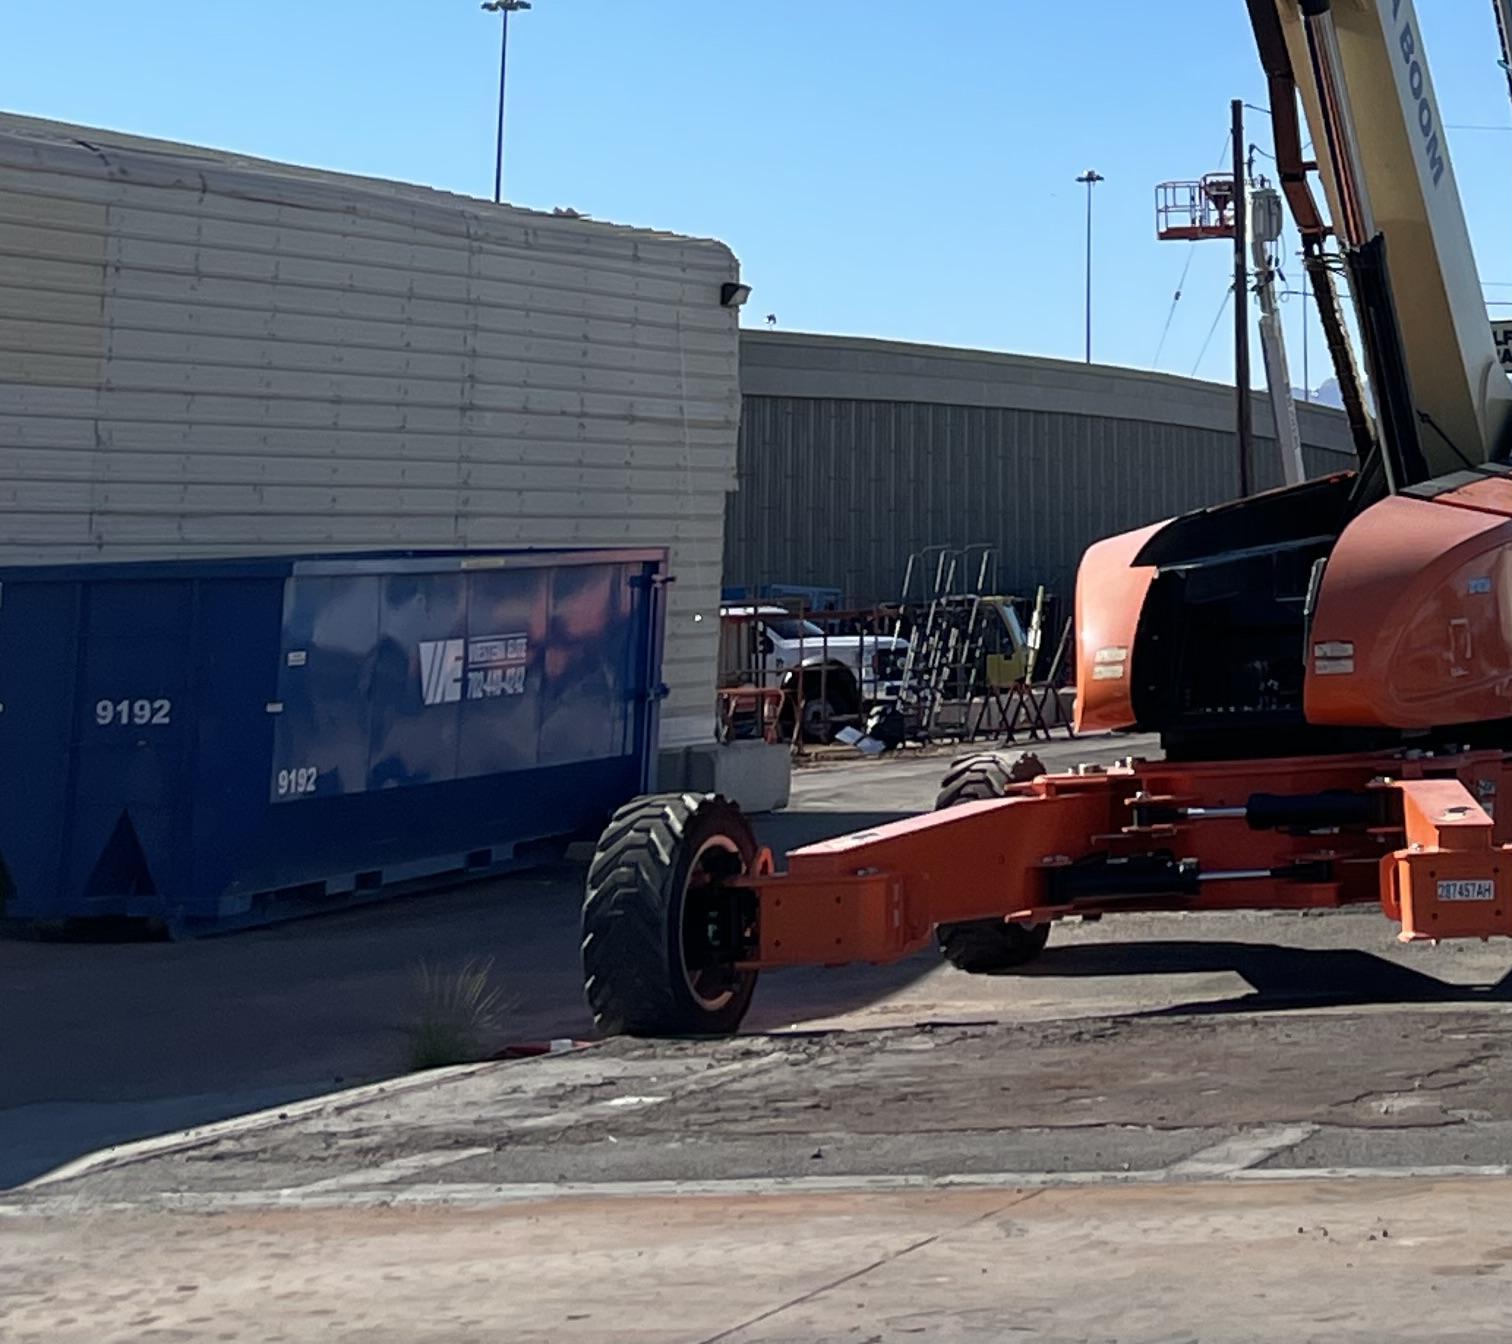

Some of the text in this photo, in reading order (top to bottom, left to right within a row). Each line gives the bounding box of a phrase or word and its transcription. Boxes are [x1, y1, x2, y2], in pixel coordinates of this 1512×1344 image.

[1400, 21, 1444, 188] BOOM
[96, 699, 171, 725] 9192
[278, 767, 317, 795] 9192
